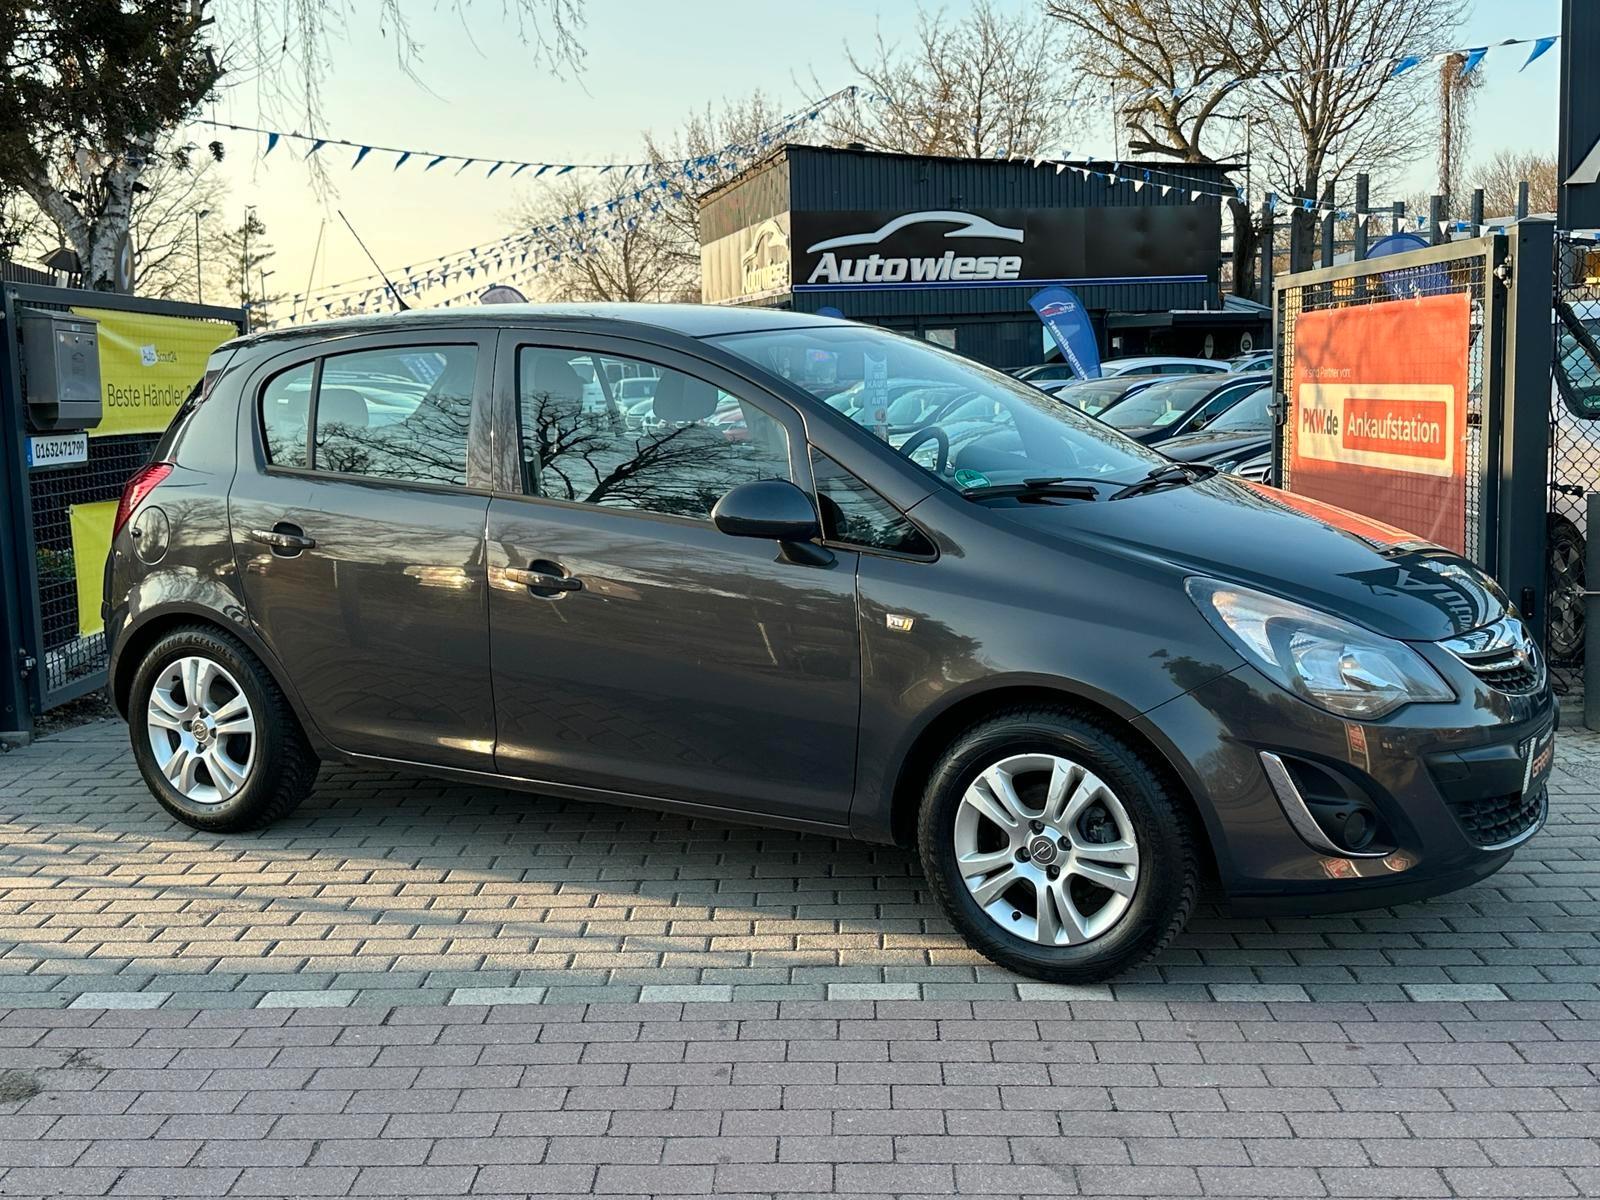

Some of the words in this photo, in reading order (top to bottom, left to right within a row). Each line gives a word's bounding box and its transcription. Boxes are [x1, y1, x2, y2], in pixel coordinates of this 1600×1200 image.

[807, 251, 1022, 284] Autowiese
[107, 383, 141, 407] Beste
[143, 384, 184, 407] Händler
[1303, 408, 1339, 436] PKW.de
[1347, 412, 1440, 444] Ankaufstation
[35, 440, 84, 459] 01632471799
